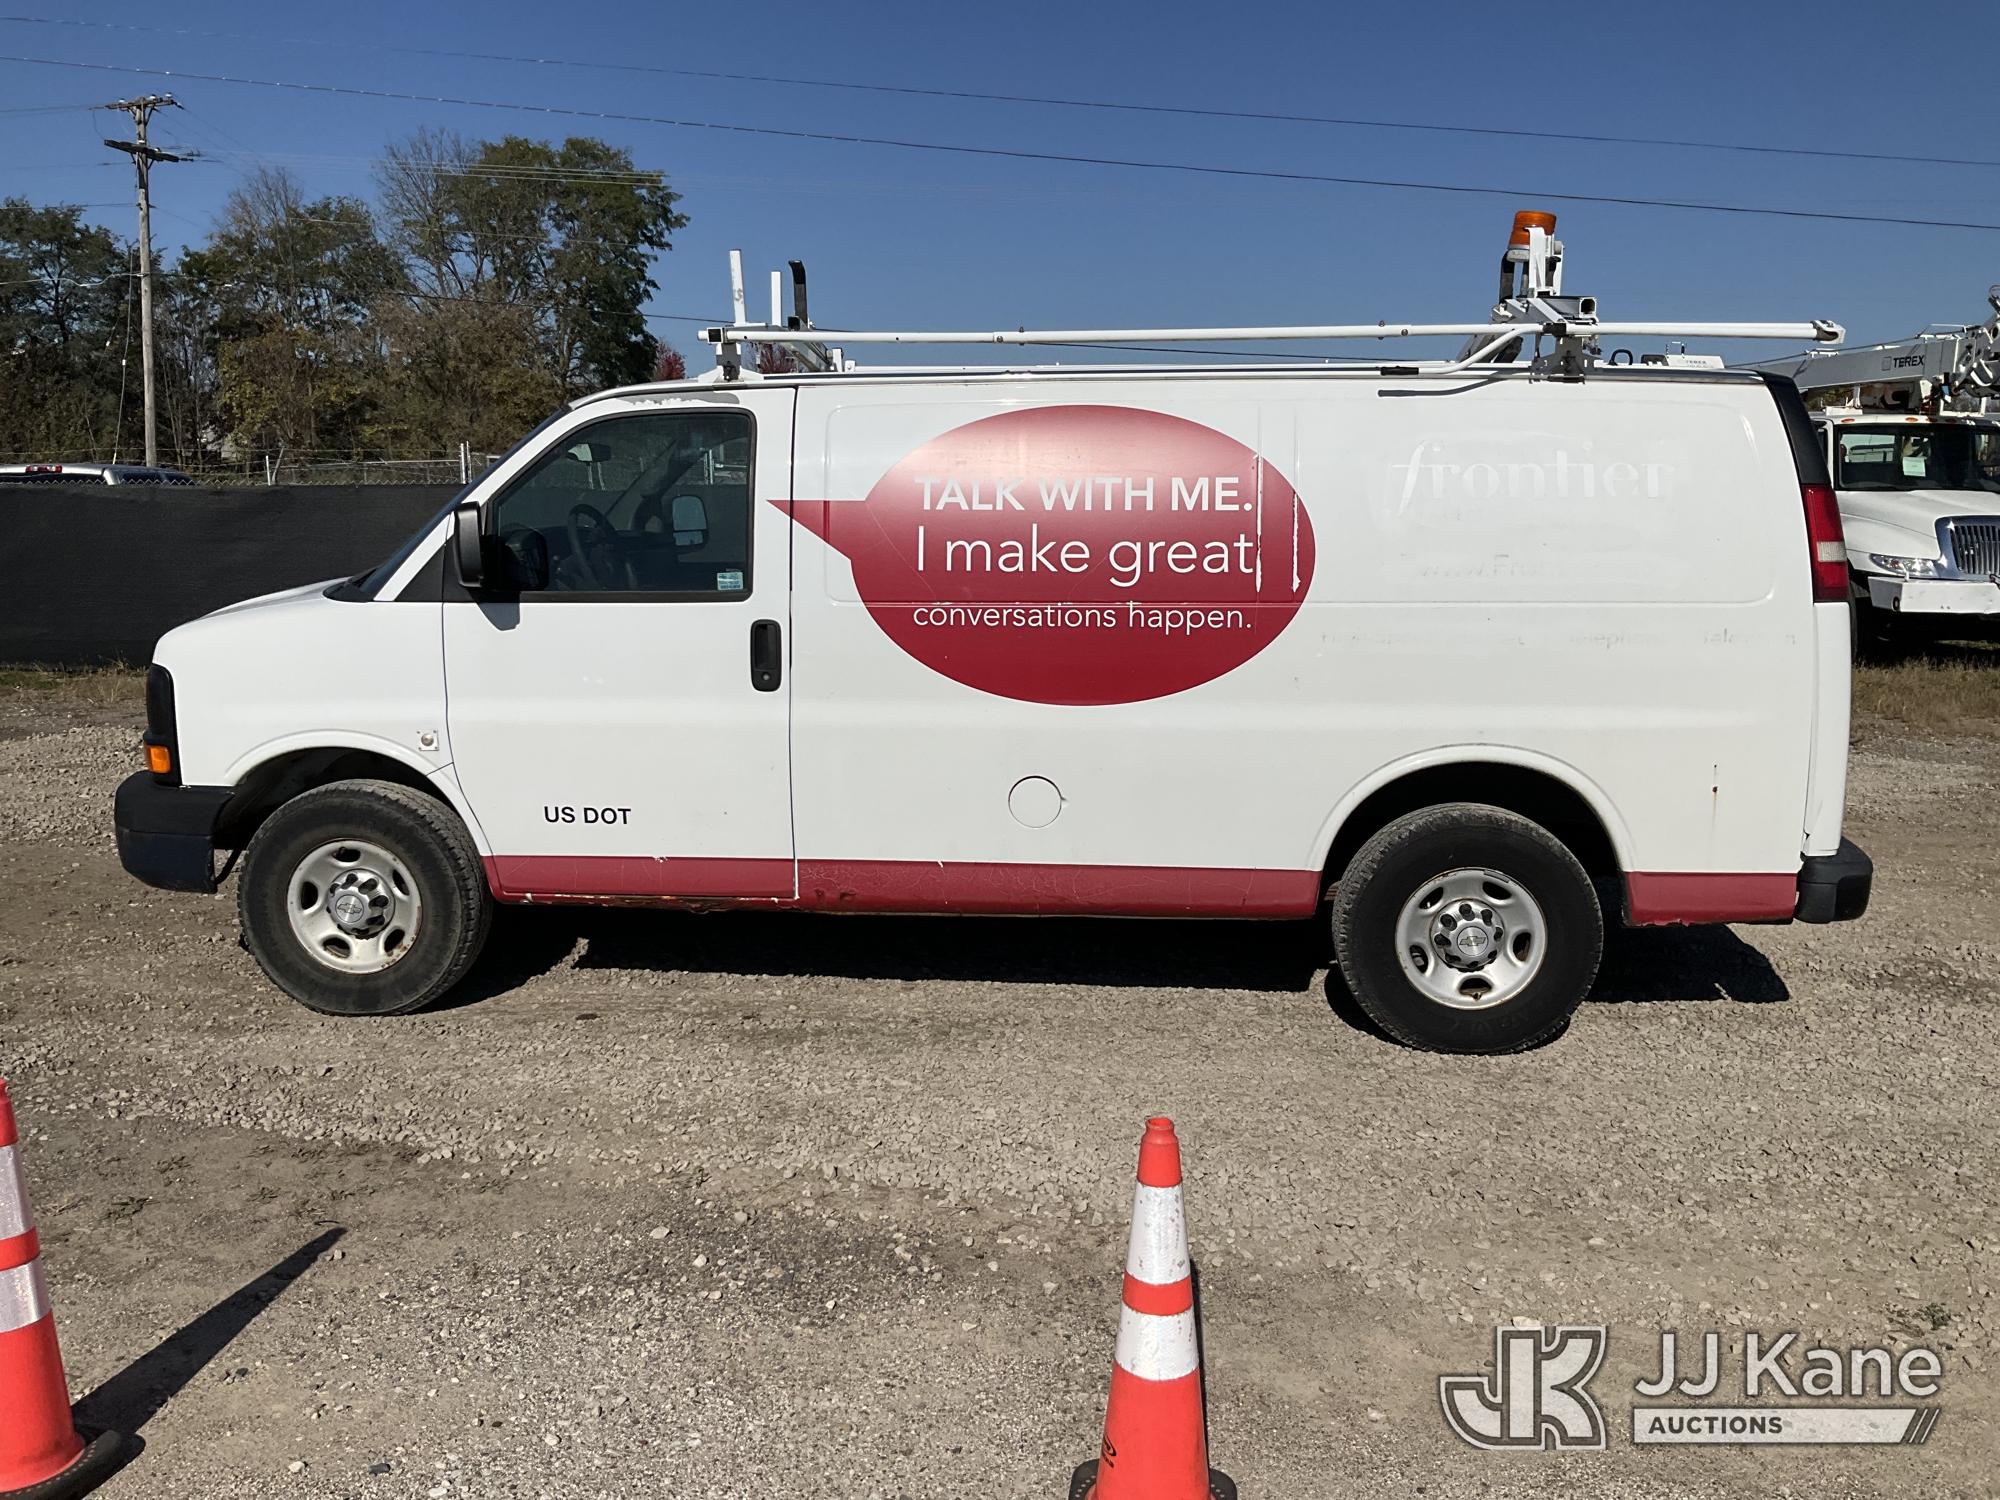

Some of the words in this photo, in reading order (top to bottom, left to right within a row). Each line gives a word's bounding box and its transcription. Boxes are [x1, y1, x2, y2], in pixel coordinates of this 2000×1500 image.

[1893, 354, 1925, 368] TEREX
[914, 476, 1025, 511] TALK
[1038, 476, 1154, 511] WITH
[1171, 476, 1253, 511] ME.
[1392, 440, 1676, 517] frontier
[918, 525, 925, 571] I
[946, 524, 1090, 573] make
[1109, 532, 1253, 588] great
[913, 602, 1117, 628] conversations
[1129, 602, 1252, 636] happen.
[544, 806, 576, 824] US
[583, 807, 632, 825] DOT
